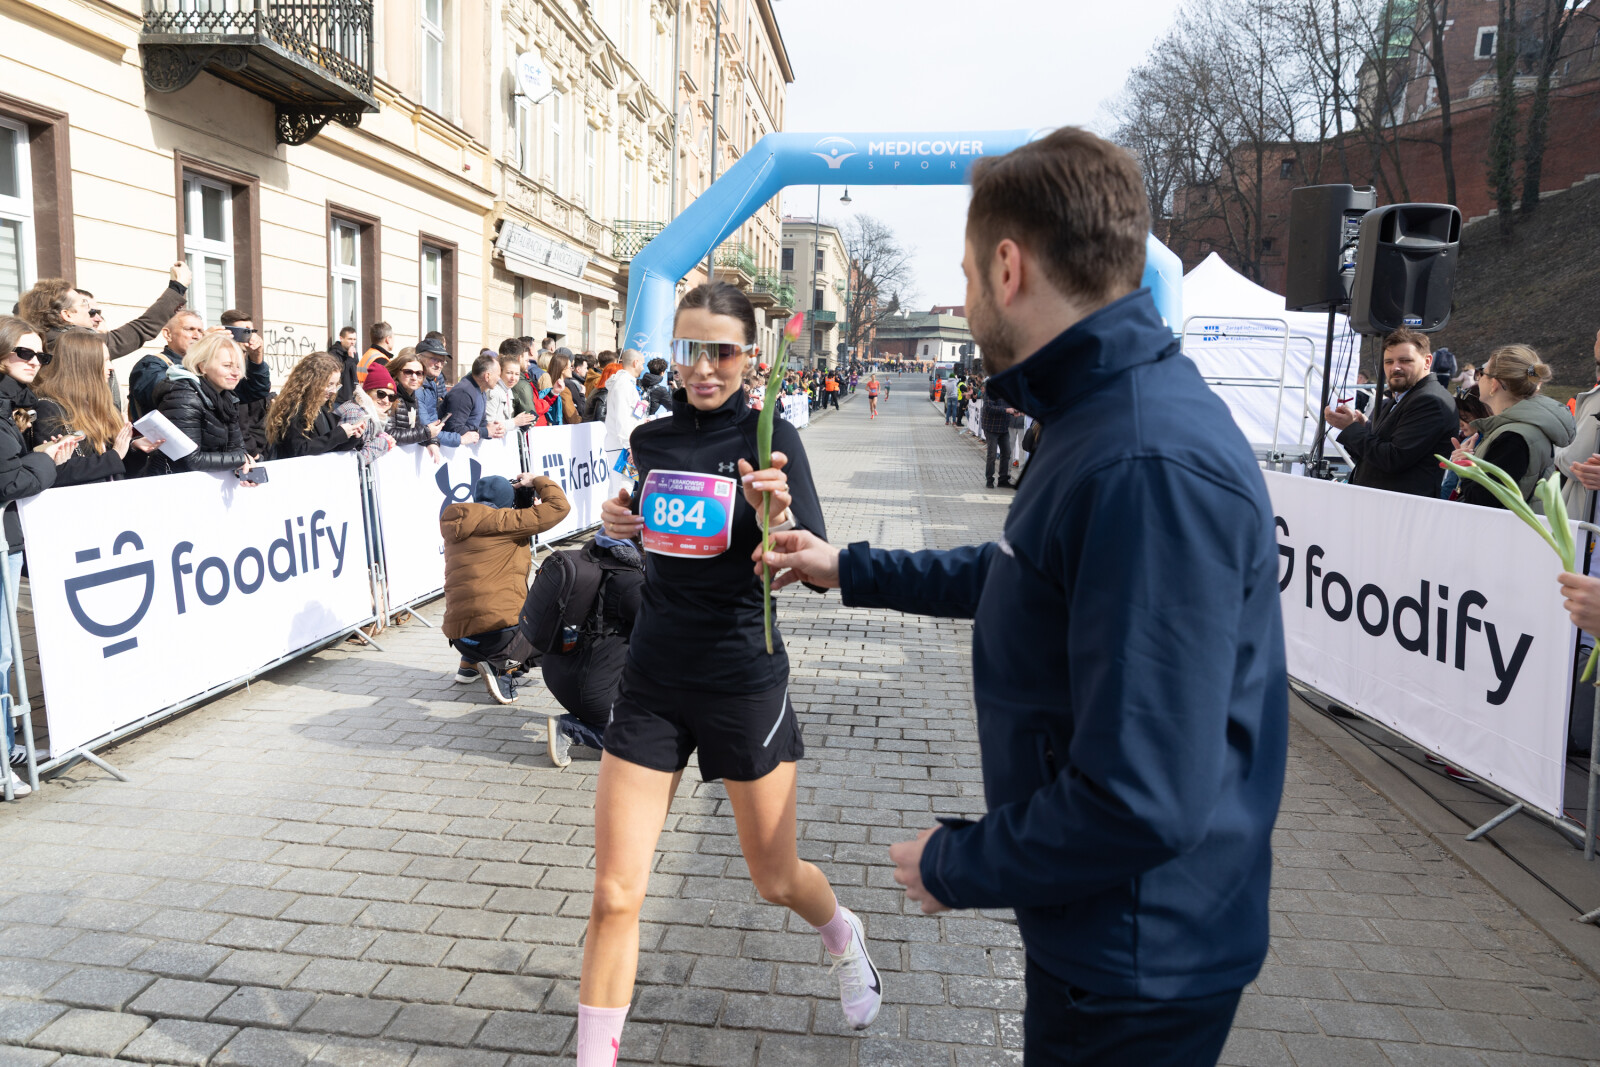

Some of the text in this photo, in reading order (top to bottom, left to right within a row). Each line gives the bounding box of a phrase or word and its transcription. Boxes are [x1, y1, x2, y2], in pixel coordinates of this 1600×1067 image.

[868, 140, 984, 156] MEDICOVER
[868, 160, 957, 170] SPOR
[653, 496, 706, 530] 884
[171, 509, 348, 614] foodify
[1305, 543, 1534, 705] foodify
